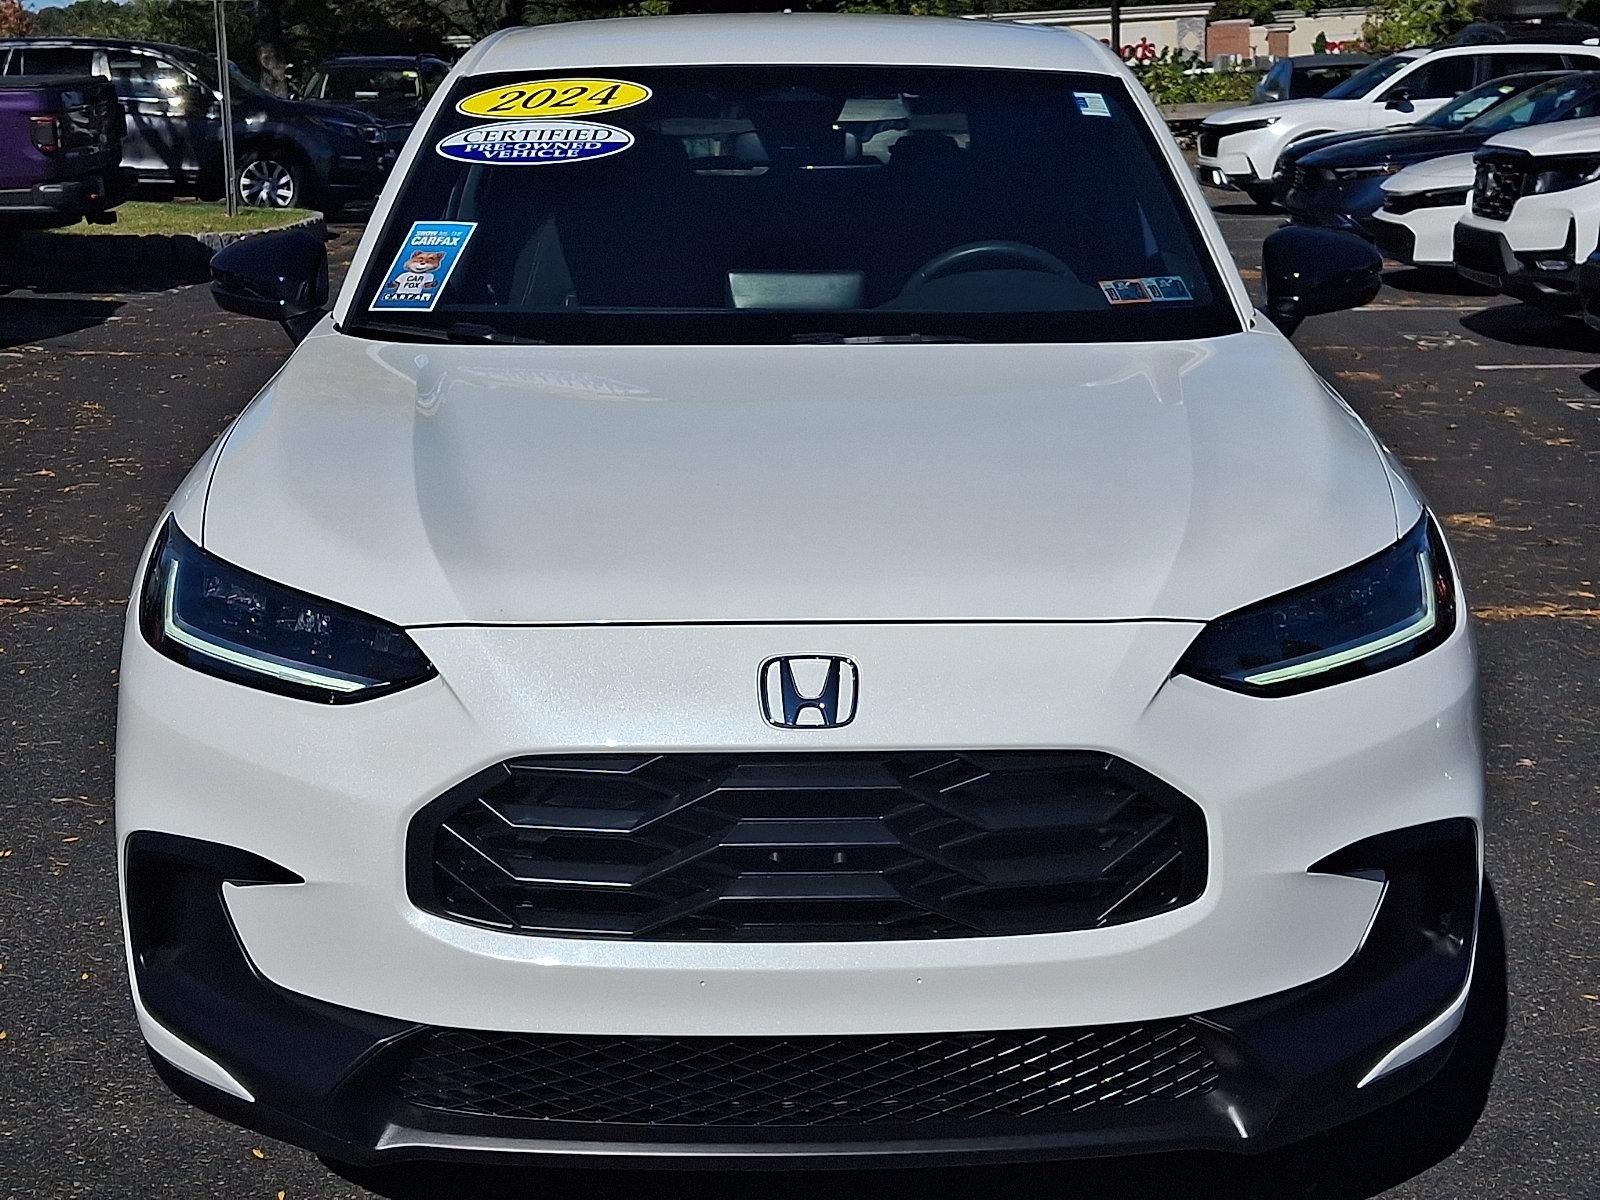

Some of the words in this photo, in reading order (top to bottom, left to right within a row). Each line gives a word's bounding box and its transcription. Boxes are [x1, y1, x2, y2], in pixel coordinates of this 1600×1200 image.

[486, 84, 621, 113] 2024
[463, 129, 613, 143] CERTIFIED
[464, 141, 602, 153] PRE-OWNED
[483, 149, 580, 159] VEHICLE
[411, 236, 461, 246] CARFAX
